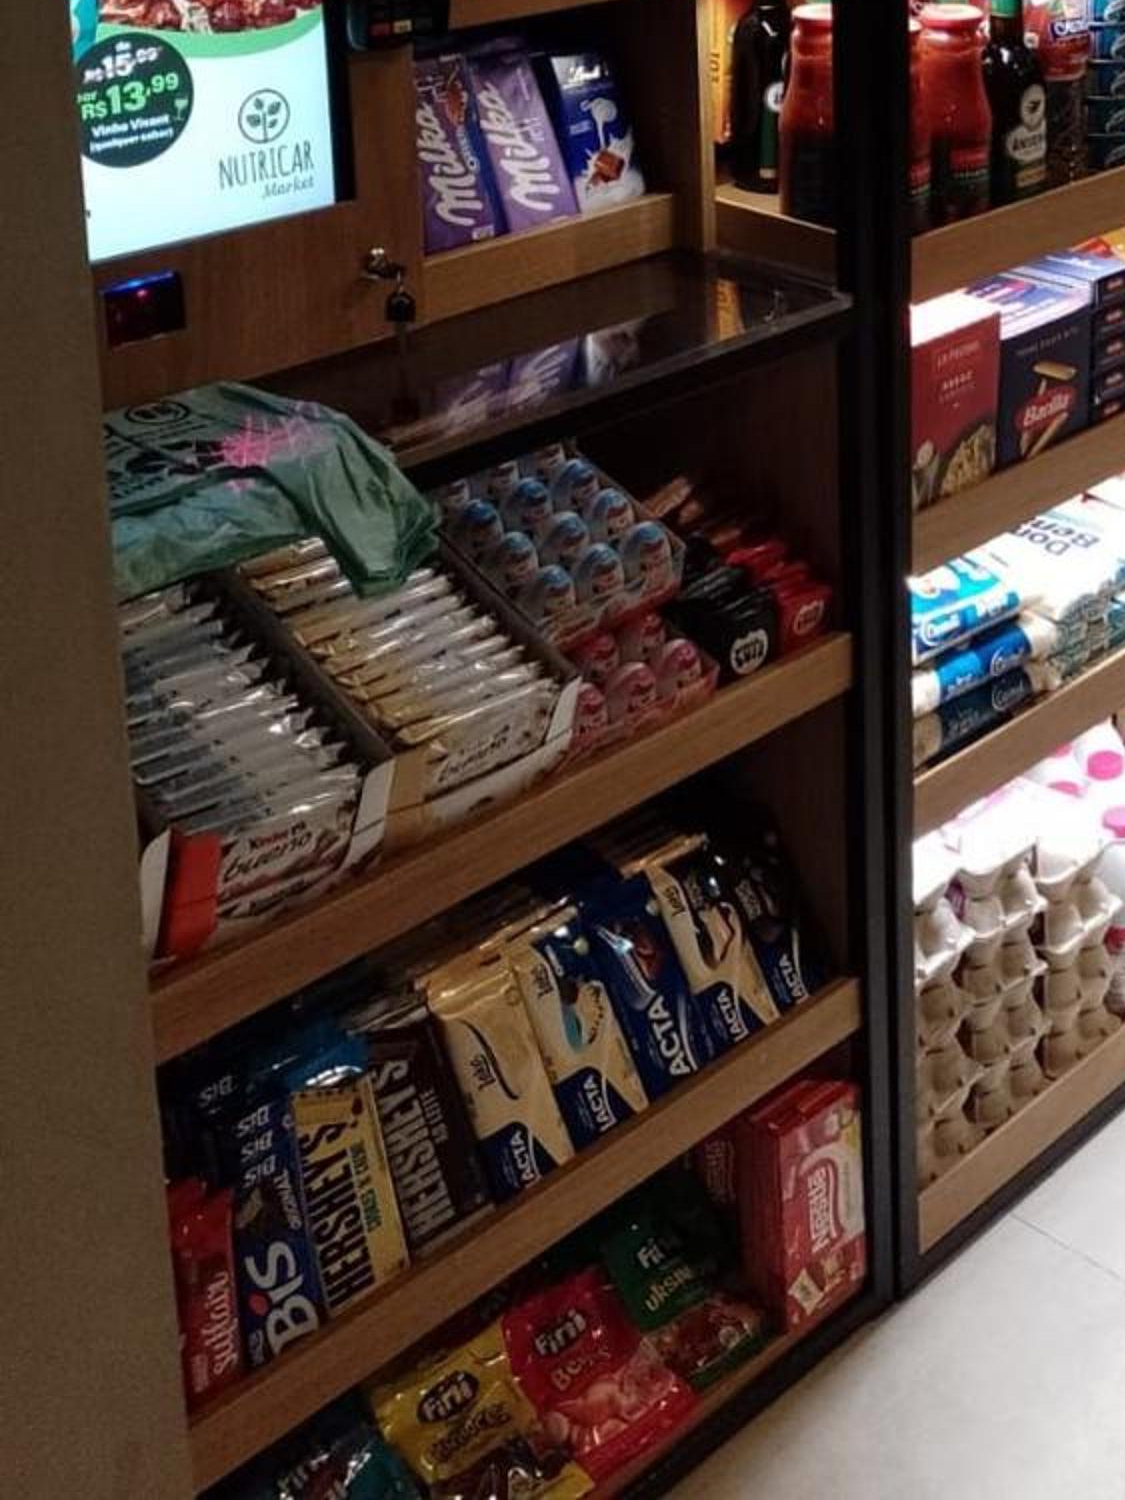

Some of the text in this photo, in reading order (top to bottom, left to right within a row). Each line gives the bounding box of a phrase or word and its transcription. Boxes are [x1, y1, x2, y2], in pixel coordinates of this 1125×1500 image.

[218, 140, 316, 190] NUTRICAR
[416, 100, 484, 227] Milka
[477, 82, 561, 212] Milka
[261, 175, 316, 200] Market
[533, 1307, 589, 1357] Fini
[421, 1373, 476, 1422] Fini
